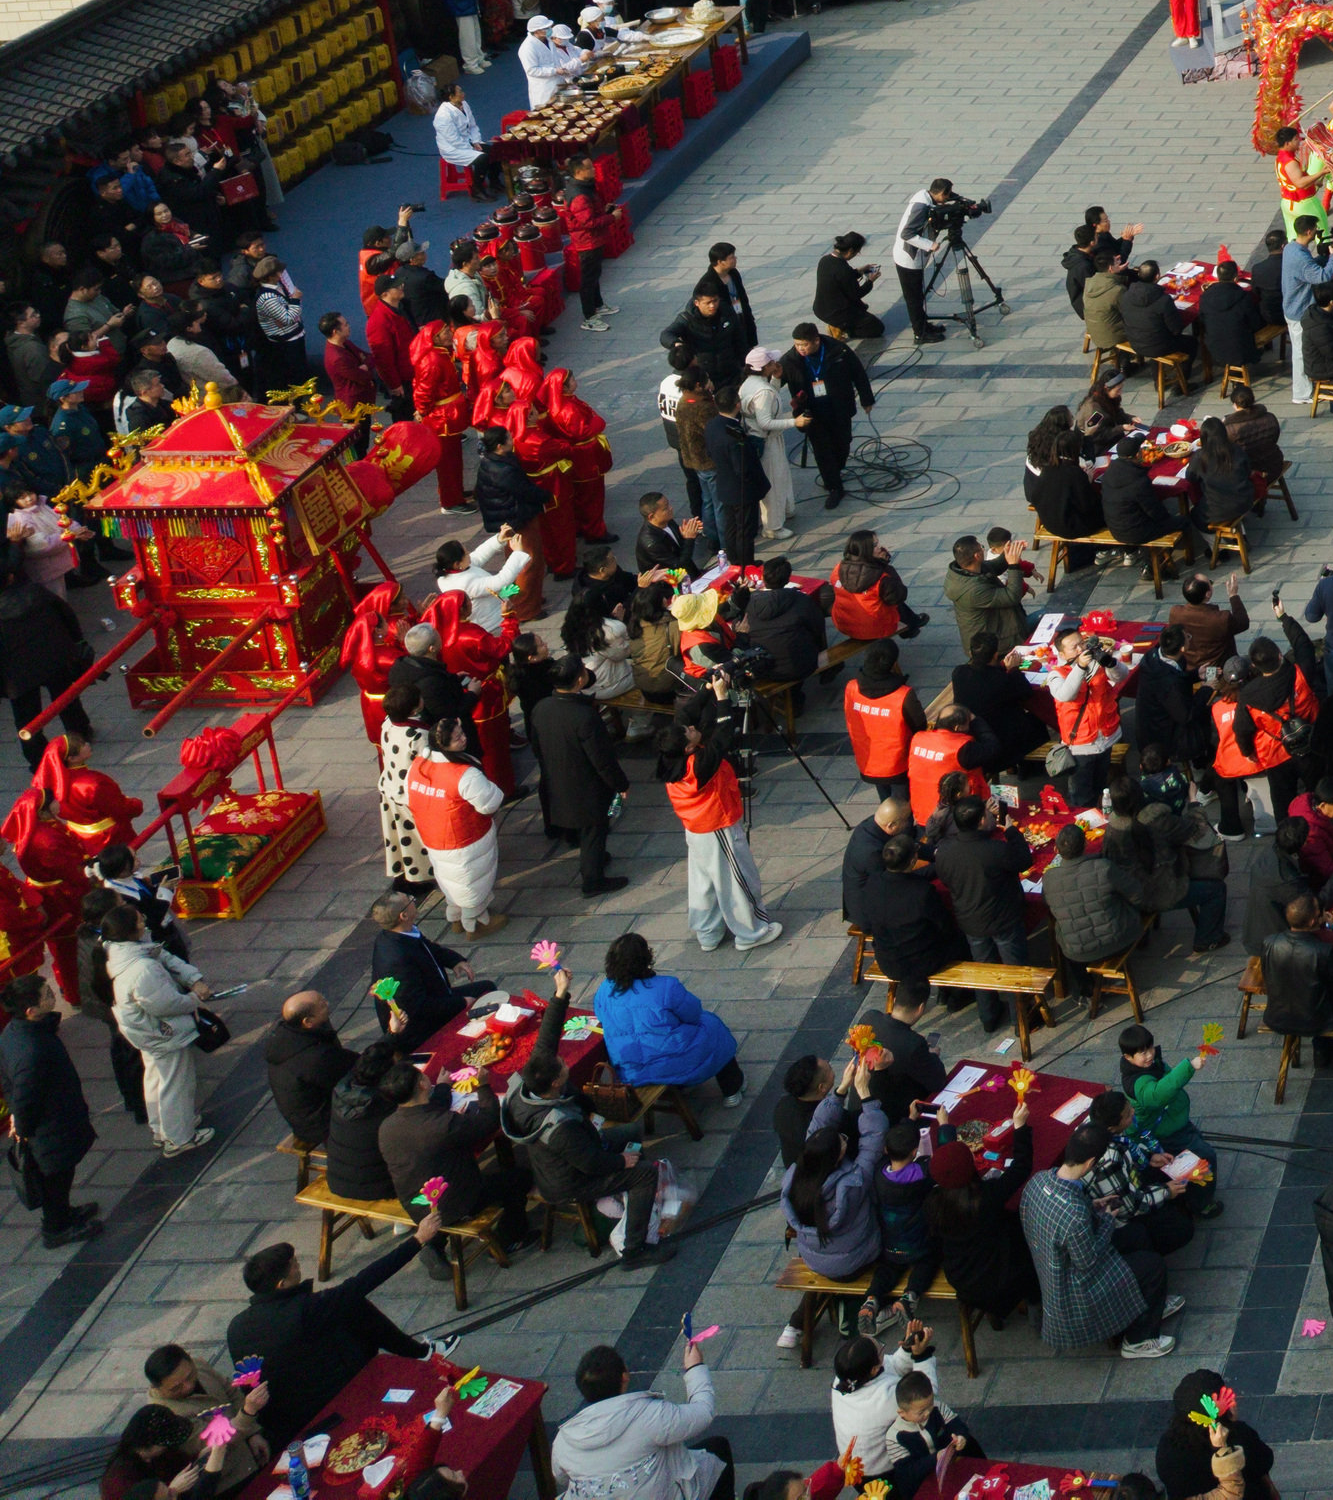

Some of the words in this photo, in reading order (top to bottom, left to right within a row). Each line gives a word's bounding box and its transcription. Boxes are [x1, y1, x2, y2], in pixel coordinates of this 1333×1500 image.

[411, 780, 446, 798] 新闻媒体
[1047, 795, 1059, 803] 25
[983, 1477, 1000, 1489] 37
